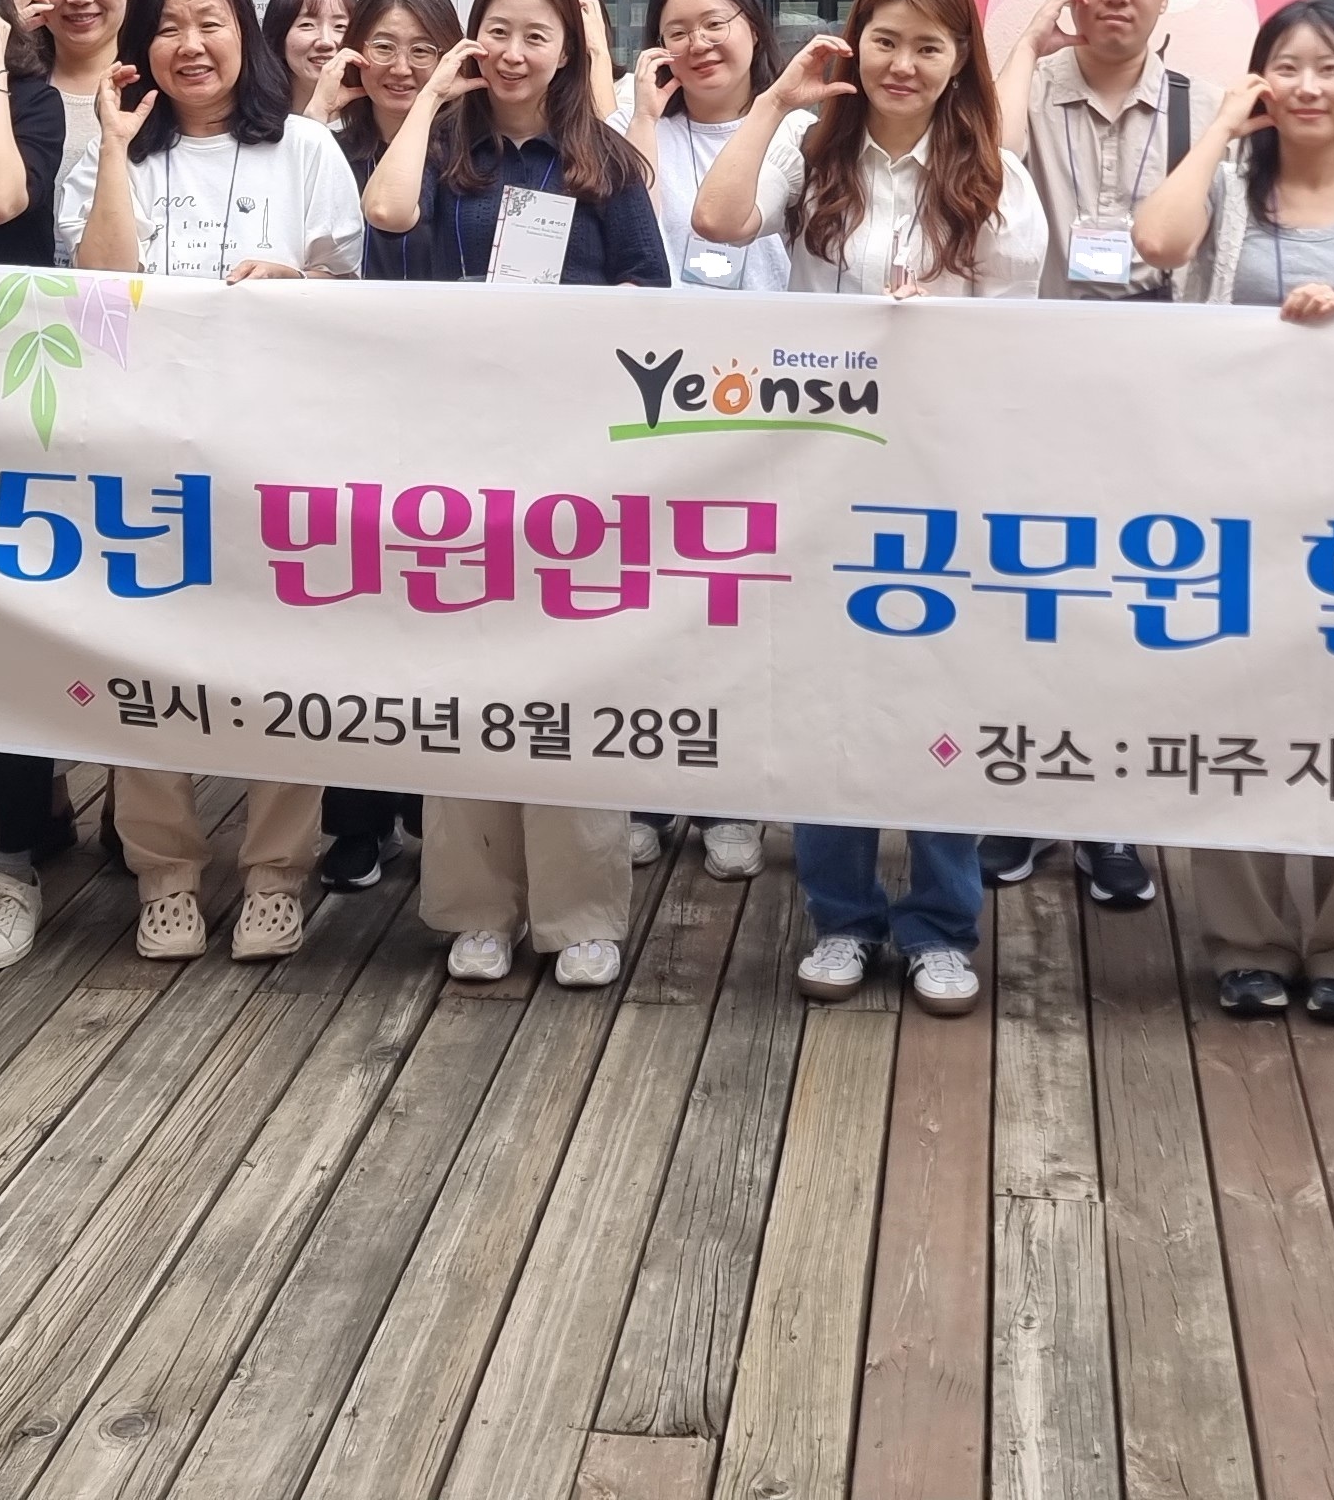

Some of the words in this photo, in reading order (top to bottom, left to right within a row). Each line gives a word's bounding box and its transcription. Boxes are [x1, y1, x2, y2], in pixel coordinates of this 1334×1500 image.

[615, 348, 879, 430] Yeonsu
[773, 349, 839, 369] Better
[844, 350, 878, 370] life
[254, 480, 793, 628] 민원업무
[833, 504, 1253, 652] 공무원
[107, 676, 212, 735] 일시
[230, 695, 244, 728] :
[262, 690, 461, 755] 2025년
[480, 701, 572, 761] 8월
[591, 706, 719, 769] 28일
[976, 723, 1095, 786] 장소
[1115, 741, 1129, 779] :
[1146, 733, 1269, 796] 파주
